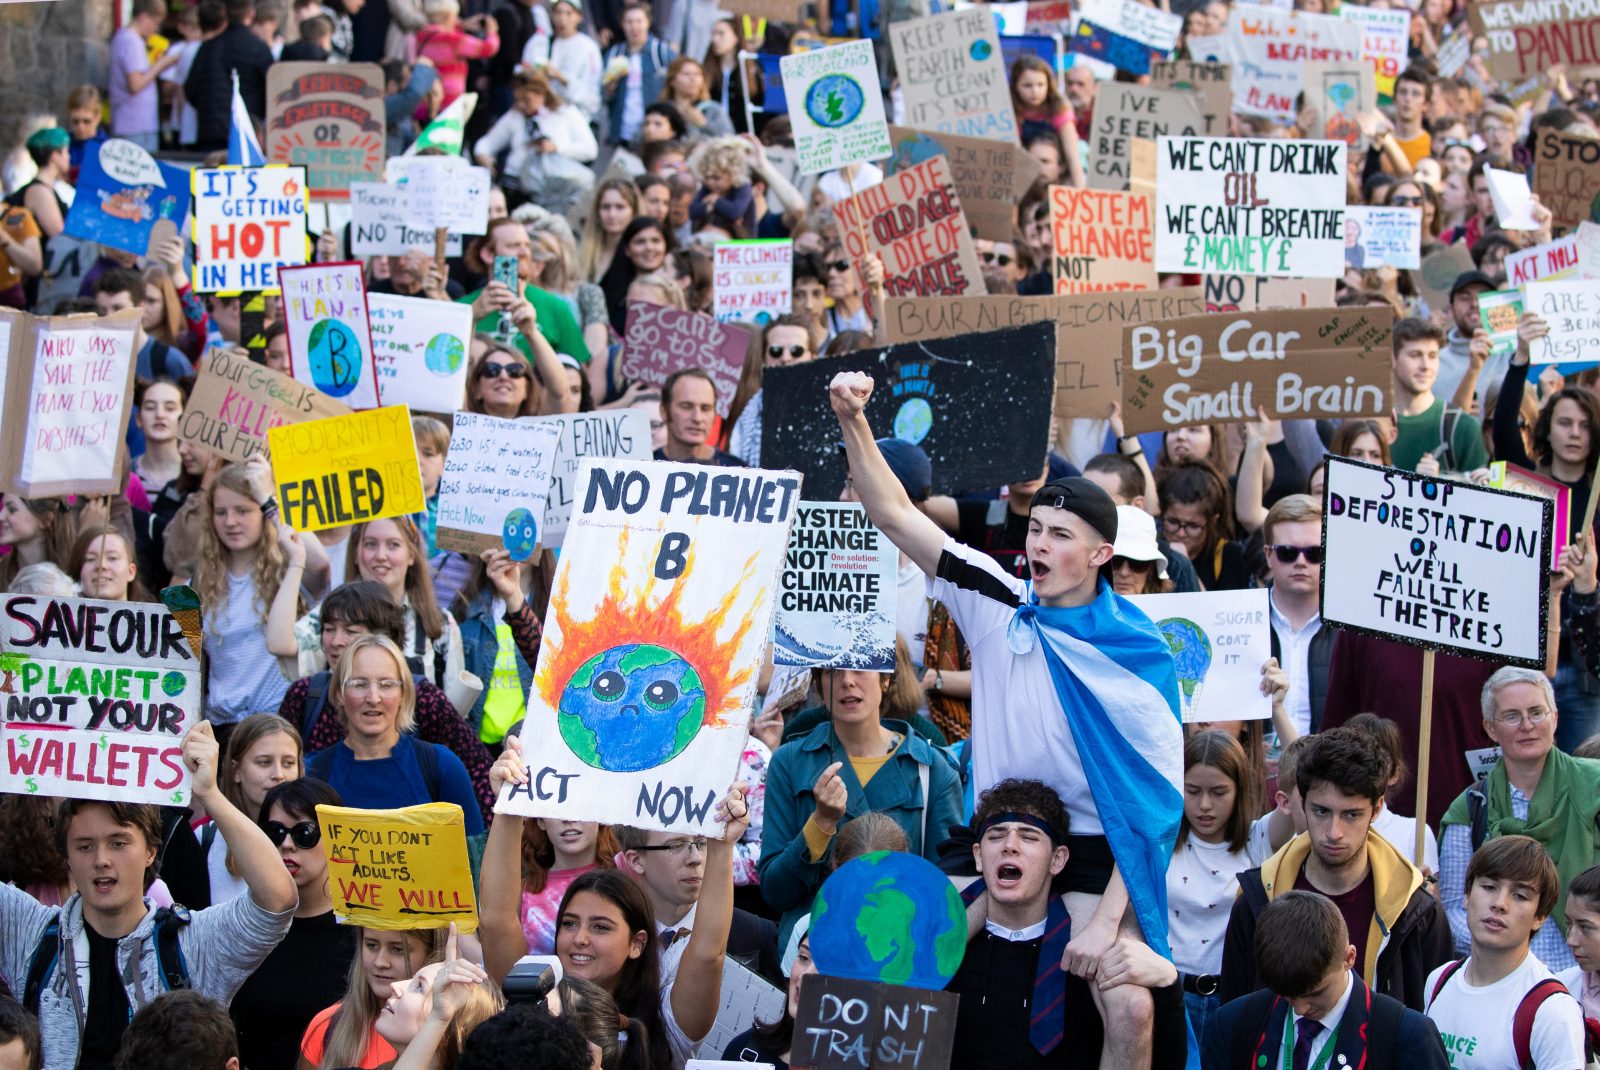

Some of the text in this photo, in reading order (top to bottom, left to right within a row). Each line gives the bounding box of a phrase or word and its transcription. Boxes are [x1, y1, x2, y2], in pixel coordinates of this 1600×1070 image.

[1479, 3, 1511, 29] WE
[900, 21, 946, 54] KEEP
[954, 11, 986, 37] THE
[1487, 29, 1517, 53] TO
[1514, 18, 1600, 74] PANIC
[905, 47, 966, 84] EARTH
[1187, 62, 1229, 82] TIME
[954, 91, 990, 113] NOT
[1120, 90, 1160, 114] I'VE
[1247, 86, 1292, 113] PLAN
[314, 123, 341, 142] OR
[1100, 115, 1169, 139] SEEN
[1168, 140, 1204, 172] WE
[1209, 141, 1260, 173] CAN'T
[1270, 143, 1340, 174] DRINK
[1541, 133, 1600, 164] STO
[202, 169, 258, 197] IT'S
[898, 157, 943, 201] DIE
[1224, 172, 1269, 206] OIL
[222, 197, 306, 217] GETTING
[1053, 188, 1149, 227] SYSTEM
[356, 223, 388, 243] NO
[1166, 205, 1197, 235] WE
[1201, 205, 1256, 237] CAN'T
[1261, 209, 1345, 240] BREATHE
[210, 220, 291, 260] HOT
[845, 222, 872, 258] OF
[893, 228, 935, 275] DIE
[934, 213, 963, 255] OF
[1054, 221, 1153, 263] CHANGE
[743, 244, 790, 265] CLIMATE
[1056, 256, 1097, 281] NOT
[202, 262, 302, 288] IN HE
[287, 274, 344, 293] THERE'S
[717, 271, 732, 288] IS
[1514, 255, 1538, 286] ACT
[371, 324, 395, 333] NLY
[898, 300, 998, 336] BURN
[1318, 316, 1340, 338] CAP
[1335, 315, 1367, 346] ENGINE
[1560, 318, 1600, 333] BEIN
[41, 335, 118, 359] MIKU SAYS
[328, 327, 351, 389] B
[667, 331, 698, 358] to
[1131, 326, 1204, 377] Big
[1218, 319, 1301, 362] Car
[44, 358, 113, 386] SAVE THE
[34, 388, 119, 415] PLANET YOU
[1162, 372, 1384, 425] Small Brain
[182, 409, 230, 451] OUR
[455, 414, 478, 428] 2019
[271, 410, 403, 462] MODERNITY
[573, 414, 633, 458] EATING
[449, 438, 542, 469] 2030 of warming
[445, 460, 468, 473] 2040
[523, 469, 547, 481] crisis
[279, 460, 424, 530] FAILED US
[439, 480, 461, 495] 2045
[466, 482, 495, 496] Scotland
[582, 466, 652, 516] NO
[659, 470, 799, 525] PLANET
[1381, 472, 1454, 507] STOP
[440, 500, 486, 526] Act Now
[1330, 491, 1539, 560] DEFORESTATION
[654, 530, 691, 581] B
[785, 550, 828, 571] NOT
[830, 552, 880, 563] One solution:
[1409, 537, 1439, 561] OR
[830, 562, 869, 571] revolution
[1393, 553, 1464, 585] WE'LL
[781, 571, 880, 594] CLIMATE
[780, 592, 878, 614] CHANGE
[4, 595, 193, 661] SAVE OUR
[1214, 610, 1265, 627] SUGAR
[1216, 635, 1252, 647] COAT
[1223, 654, 1242, 665] IT
[21, 662, 160, 701] PLANET
[6, 695, 186, 736] NOT YOUR
[6, 737, 185, 791] WALLETS
[508, 765, 717, 828] ACT NOW
[327, 824, 433, 846] IF YOU DONT
[331, 843, 408, 865] ACT LIKE
[352, 863, 416, 884] ADULTS,
[338, 877, 473, 910] WE WILL
[818, 993, 939, 1035] DON'T
[805, 1027, 926, 1070] TRASH
